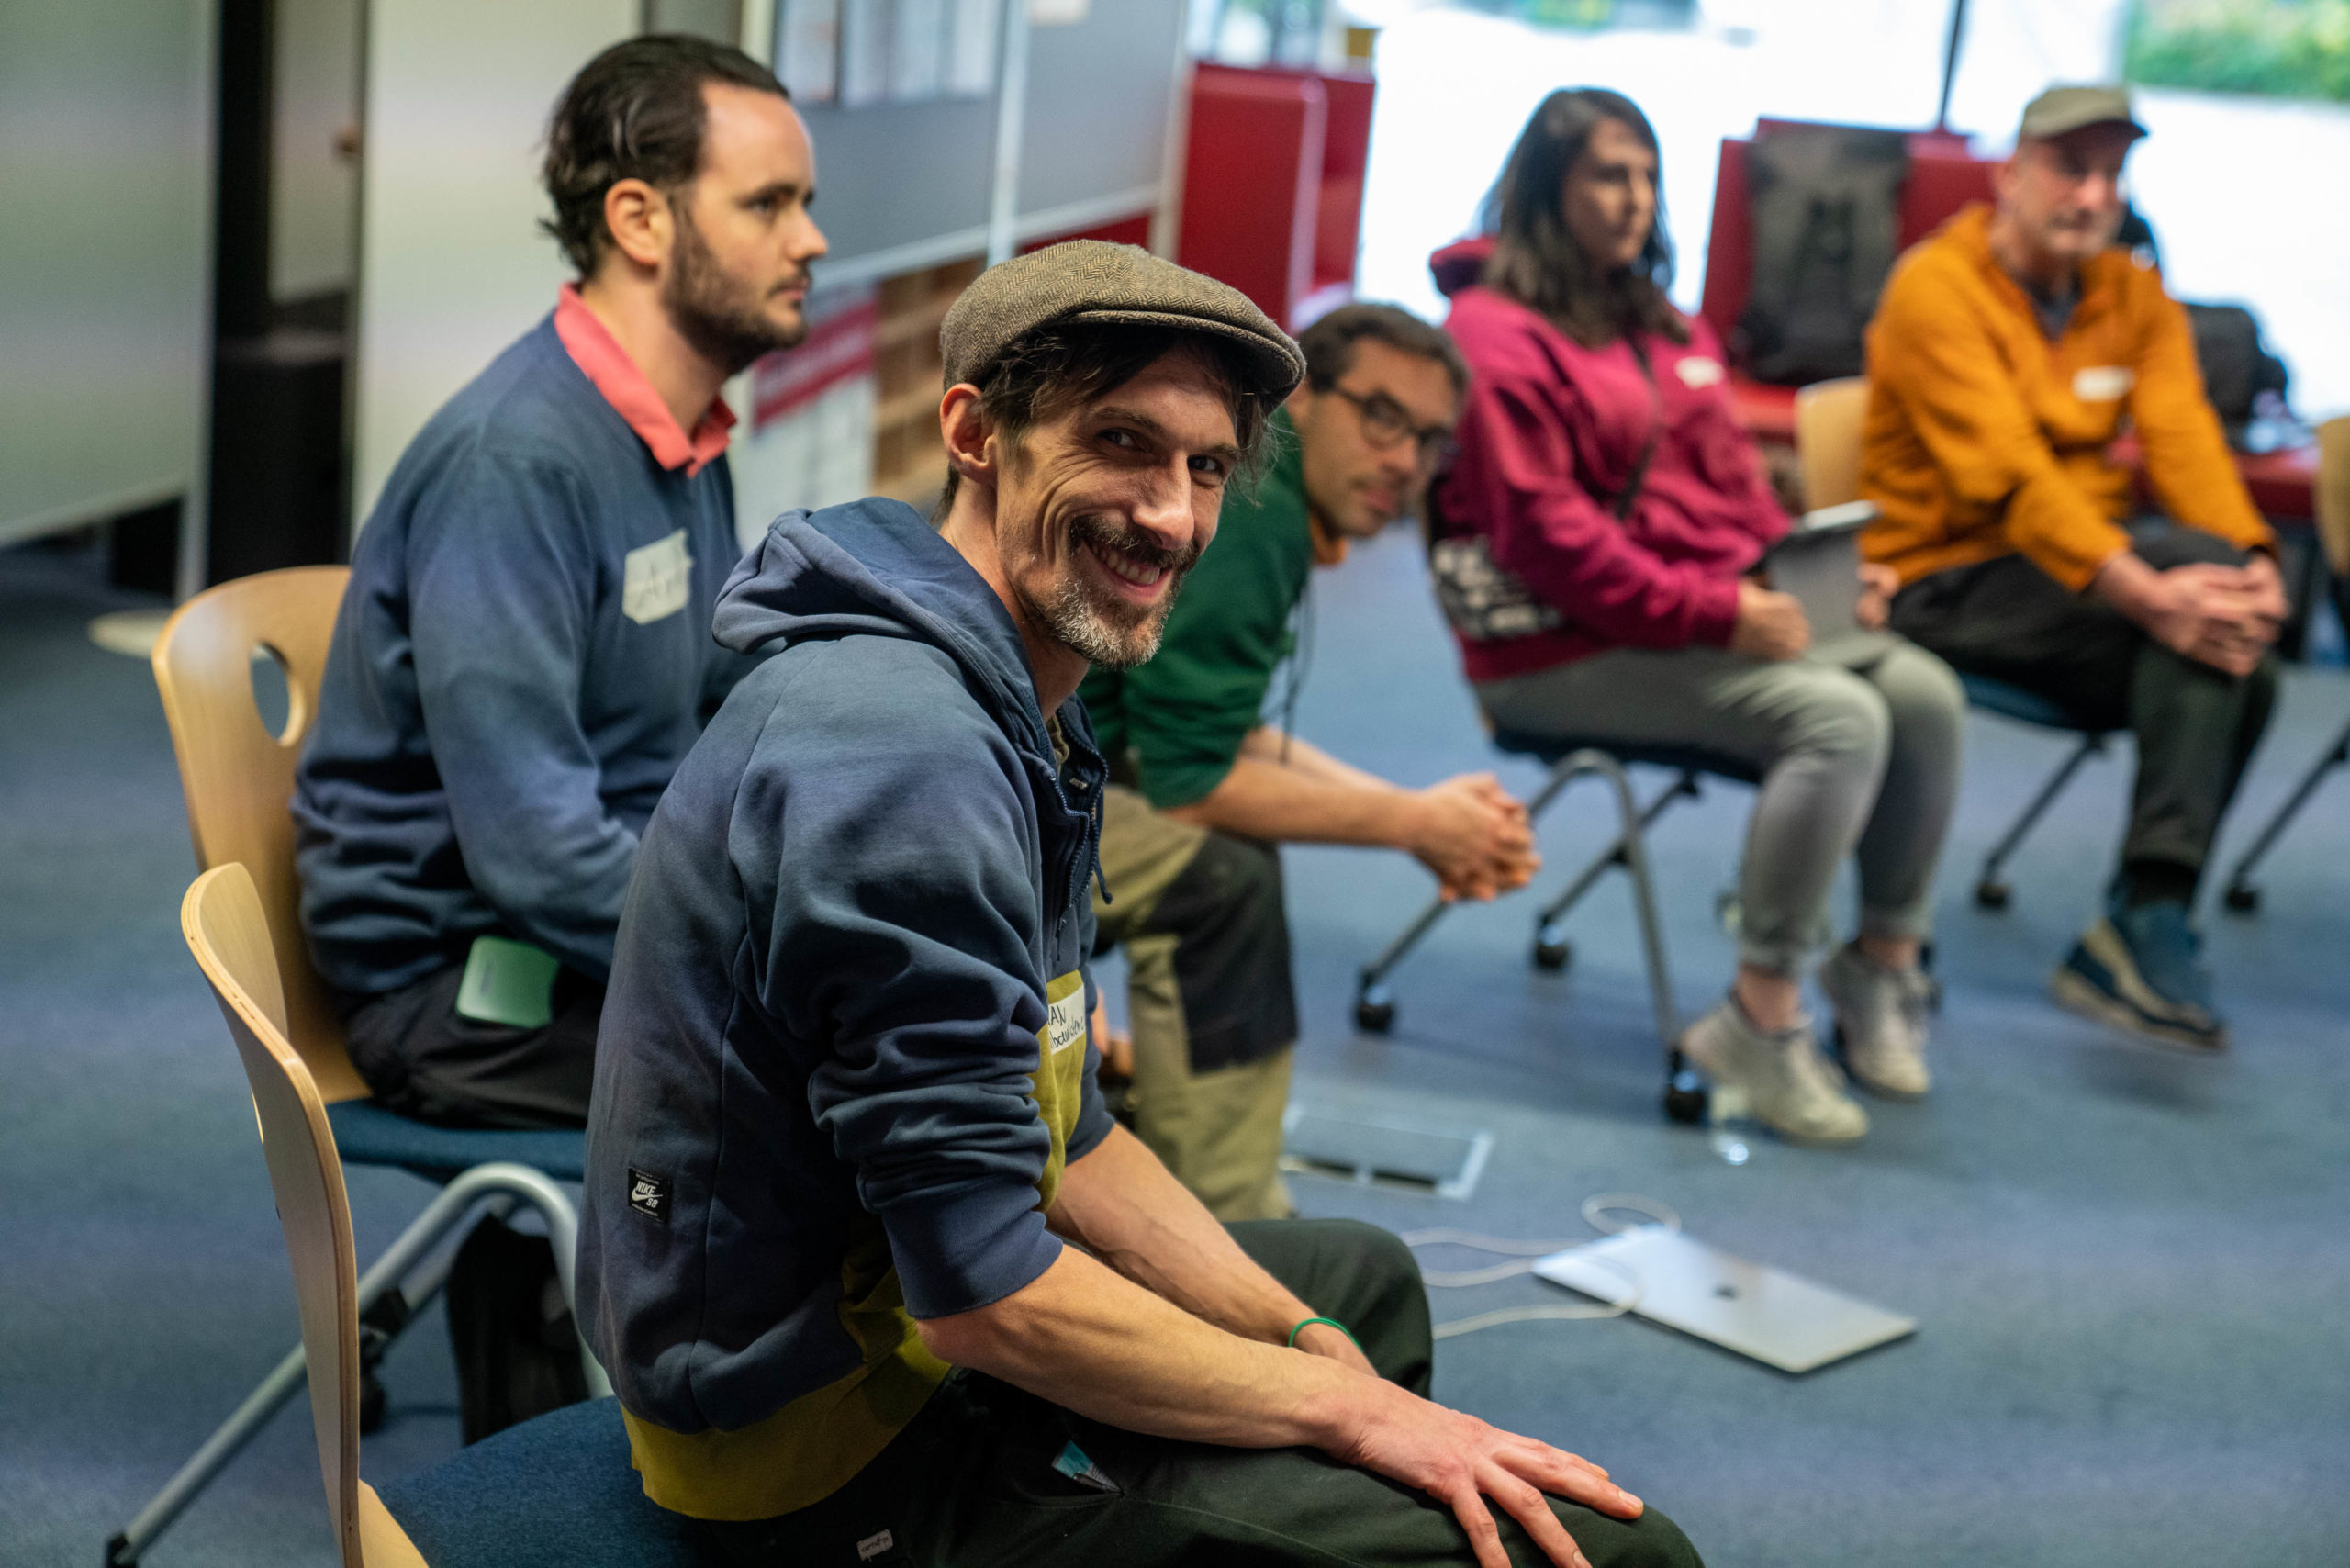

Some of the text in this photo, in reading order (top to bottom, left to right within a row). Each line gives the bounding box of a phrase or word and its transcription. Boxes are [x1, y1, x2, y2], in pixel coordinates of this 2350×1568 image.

[1048, 1004, 1067, 1027] AN
[635, 1181, 656, 1196] NIKE
[645, 1197, 659, 1208] SB
